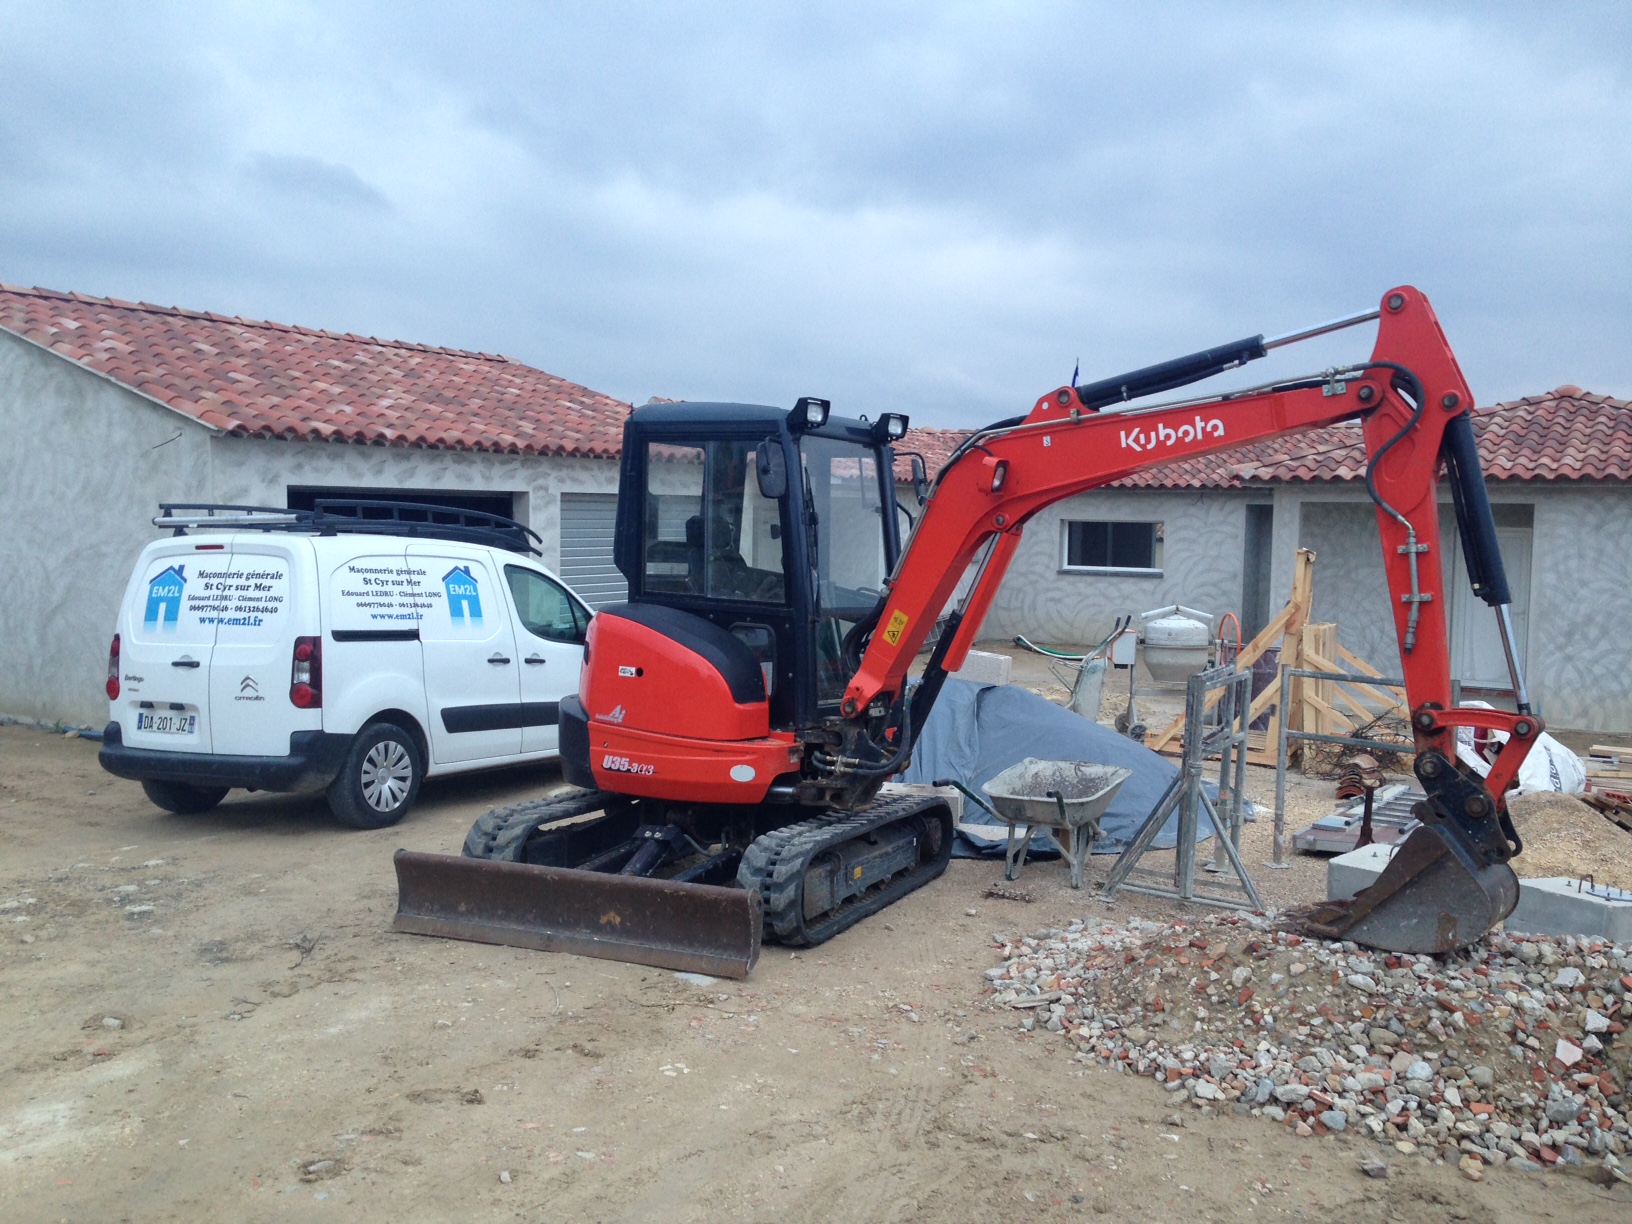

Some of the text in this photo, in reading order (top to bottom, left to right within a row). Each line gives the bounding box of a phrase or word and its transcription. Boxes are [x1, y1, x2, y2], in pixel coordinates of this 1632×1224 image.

[1119, 415, 1225, 452] Kubota
[197, 570, 283, 582] Maçonnerie générale
[348, 566, 394, 576] Maçonnerie
[203, 582, 213, 591] St
[216, 582, 233, 593] Cyr
[253, 583, 273, 592] Mer
[362, 577, 373, 586] St
[374, 578, 389, 587] Cyr
[406, 579, 421, 587] Mer
[152, 586, 180, 597] EM2L
[371, 590, 394, 598] LEDRU
[449, 584, 477, 595] EM2L
[187, 594, 211, 602] Edouard
[212, 594, 234, 602] LEDRU
[264, 595, 283, 603] LONG
